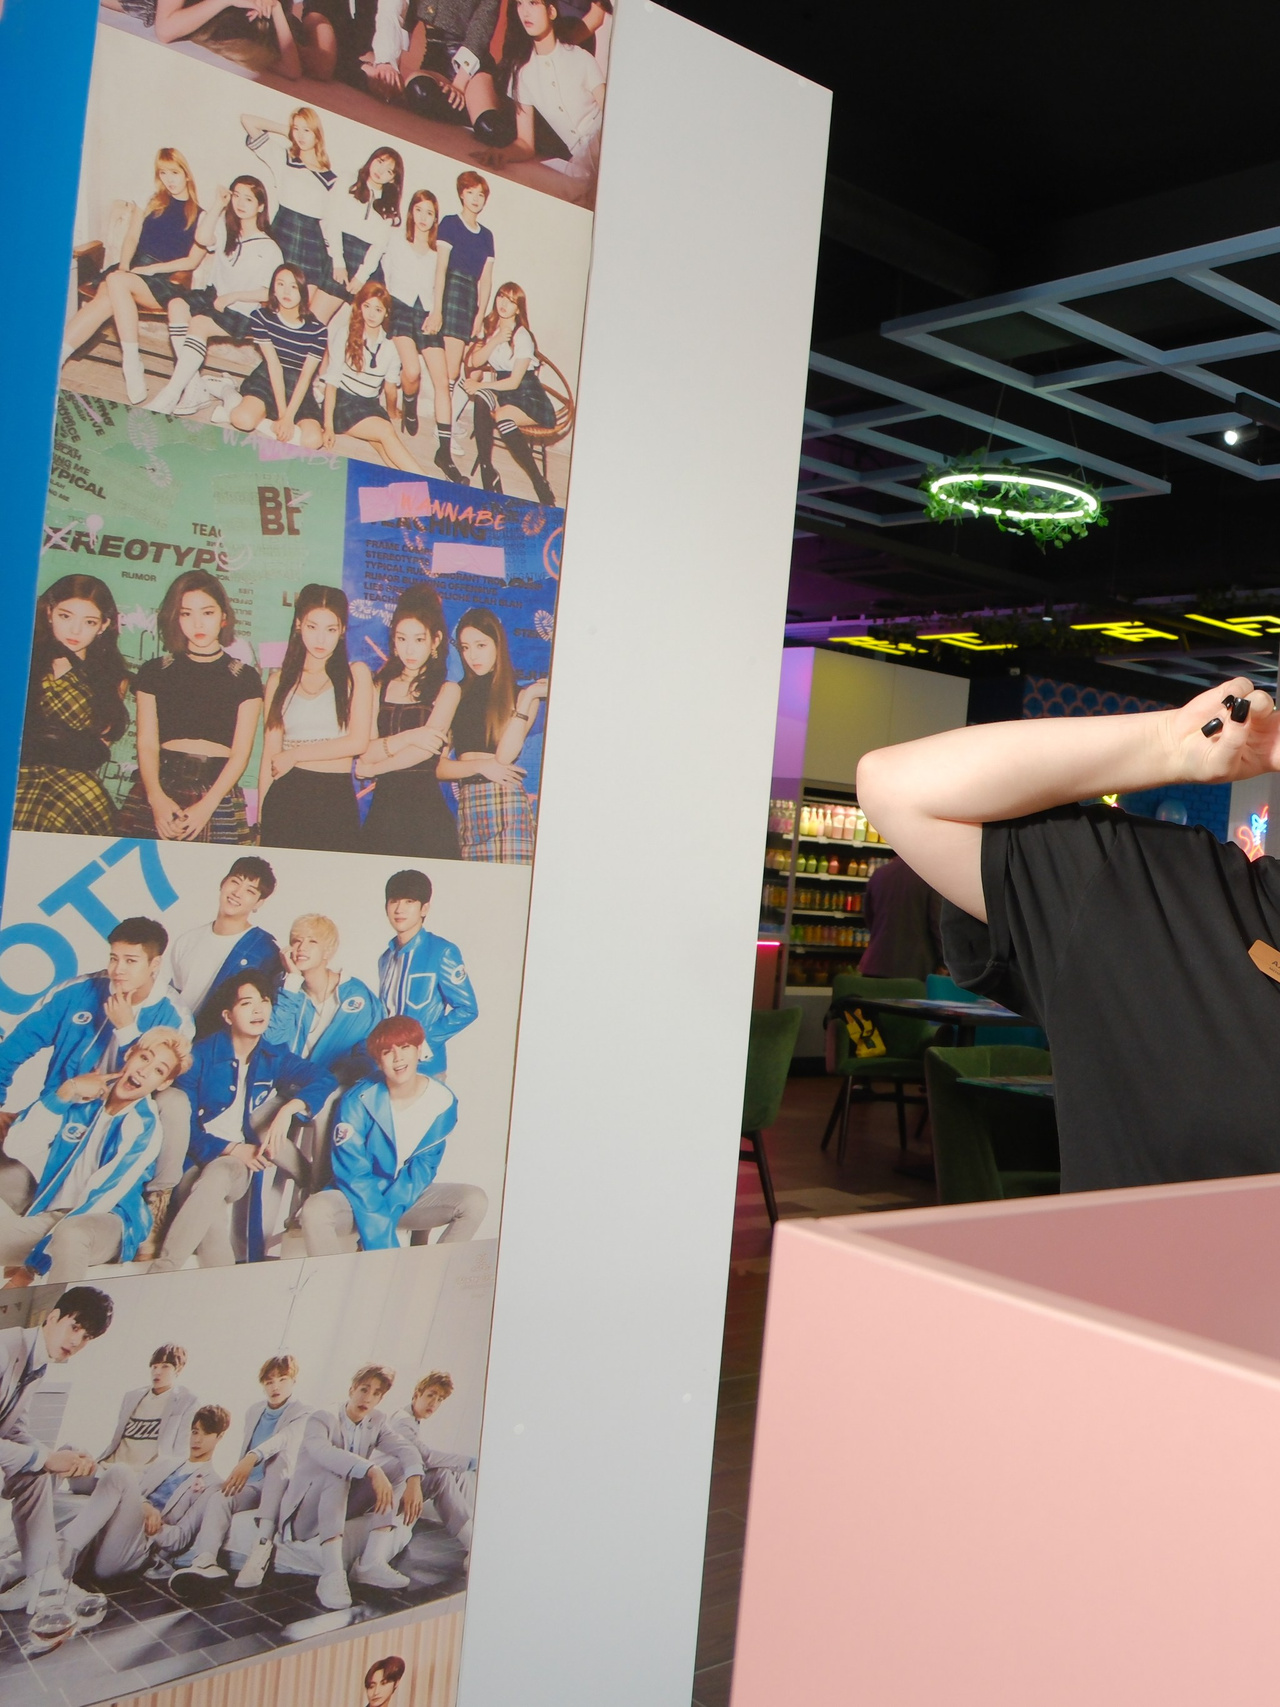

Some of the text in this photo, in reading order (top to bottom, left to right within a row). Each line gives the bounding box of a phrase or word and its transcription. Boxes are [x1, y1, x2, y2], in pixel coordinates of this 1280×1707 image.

[50, 467, 107, 500] YPICAL
[401, 492, 506, 531] WANNABE
[121, 570, 157, 583] RUMOR
[0, 837, 180, 1018] OT7
